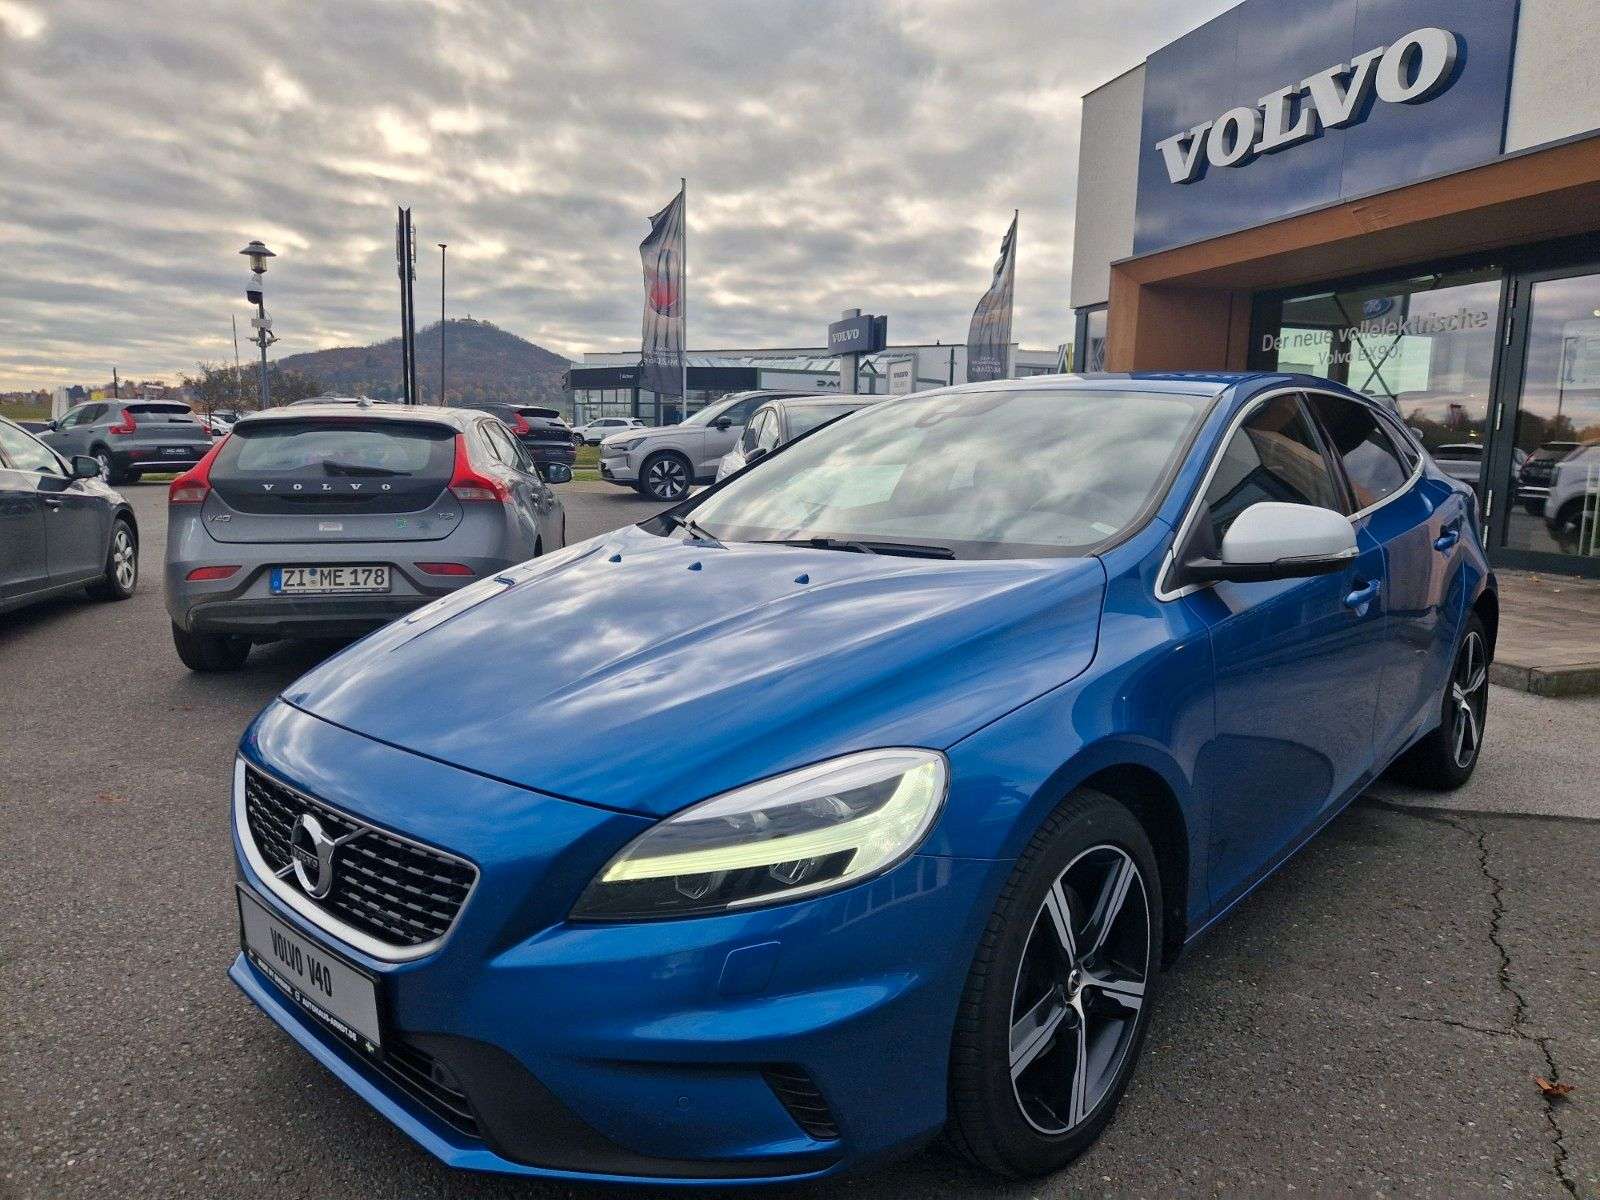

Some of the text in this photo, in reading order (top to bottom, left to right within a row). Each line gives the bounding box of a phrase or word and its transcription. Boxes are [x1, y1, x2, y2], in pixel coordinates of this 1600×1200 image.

[1155, 27, 1458, 184] VOLVO
[832, 328, 859, 342] VOLVO
[1262, 333, 1289, 352] Der
[1294, 329, 1334, 348] neue
[1319, 349, 1352, 366] Volvo
[262, 483, 391, 491] VOLVO
[283, 568, 385, 587] ZI ME 178
[270, 926, 303, 977] VOLVO
[307, 954, 333, 997] V40
